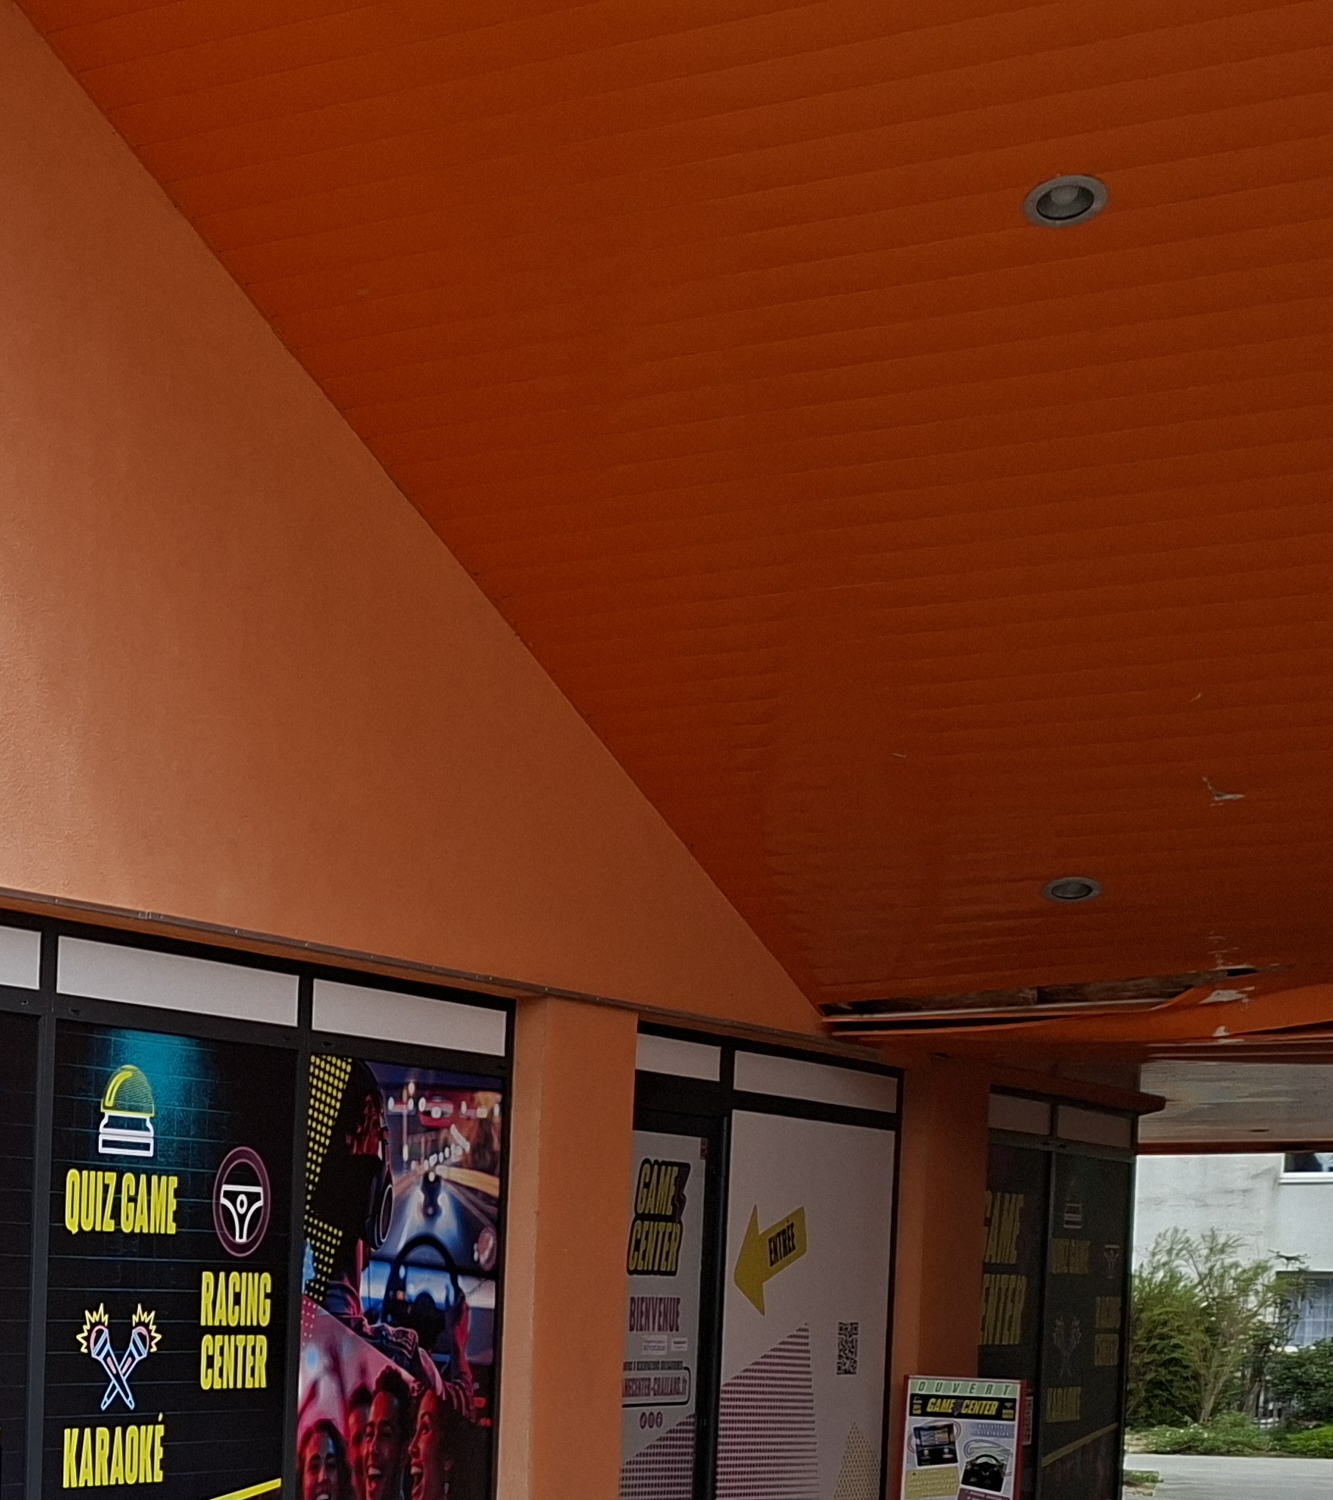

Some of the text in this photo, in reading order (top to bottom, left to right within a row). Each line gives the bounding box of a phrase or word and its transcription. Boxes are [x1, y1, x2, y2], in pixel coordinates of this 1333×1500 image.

[65, 1168, 178, 1235] QUIZ GAME
[636, 1163, 679, 1215] GAME
[628, 1220, 681, 1271] CENTER
[200, 1271, 272, 1327] RACING
[629, 1296, 680, 1332] BIENVENUE
[200, 1334, 268, 1390] CENTER
[918, 1381, 1011, 1396] OUVERT
[926, 1398, 956, 1413] GAME
[961, 1400, 999, 1415] CENTER
[62, 1412, 165, 1488] KARAOKÉ
